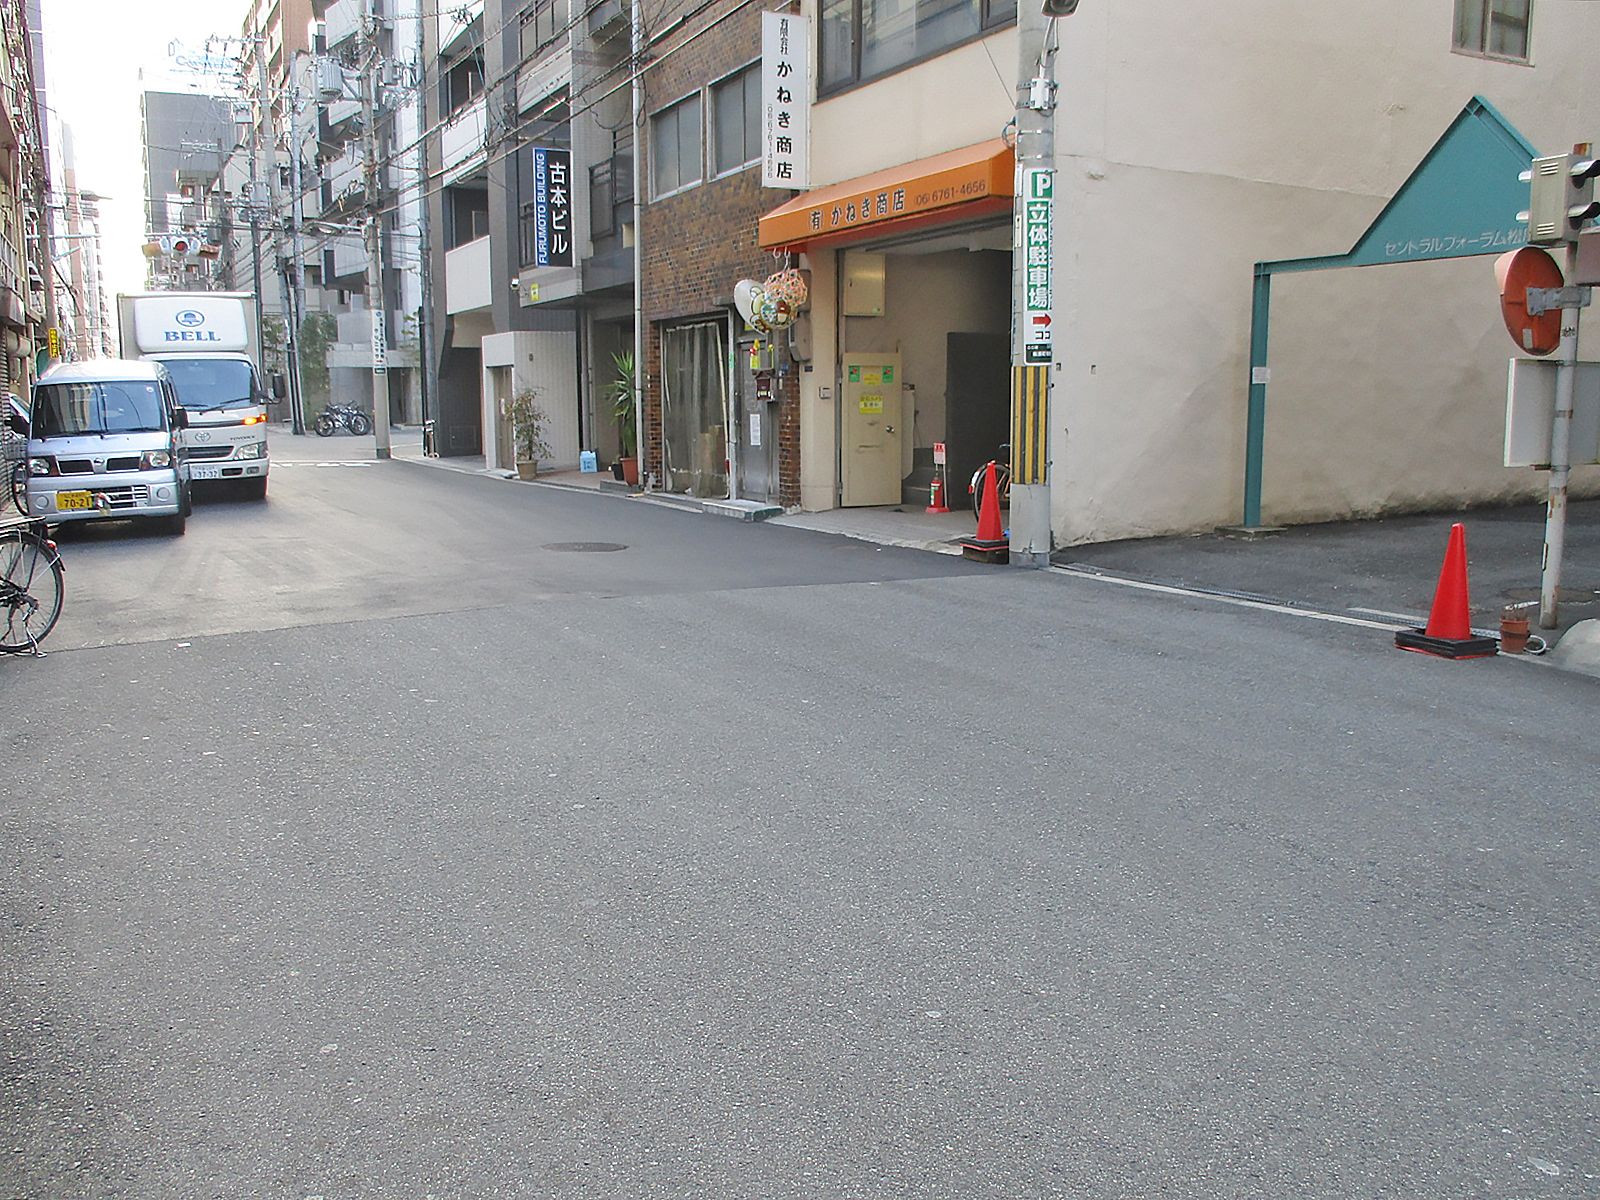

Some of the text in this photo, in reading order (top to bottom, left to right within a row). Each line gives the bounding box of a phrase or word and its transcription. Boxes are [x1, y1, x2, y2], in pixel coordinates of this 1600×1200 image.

[776, 61, 793, 179] かねき商店
[536, 153, 547, 264] FURUMOTO BUILDING
[549, 161, 568, 254] 古本ビル
[1036, 173, 1051, 197] P
[1028, 203, 1048, 308] 立体駐車場
[1385, 228, 1528, 256] セントラルフォーラム松
[164, 331, 221, 341] BELL
